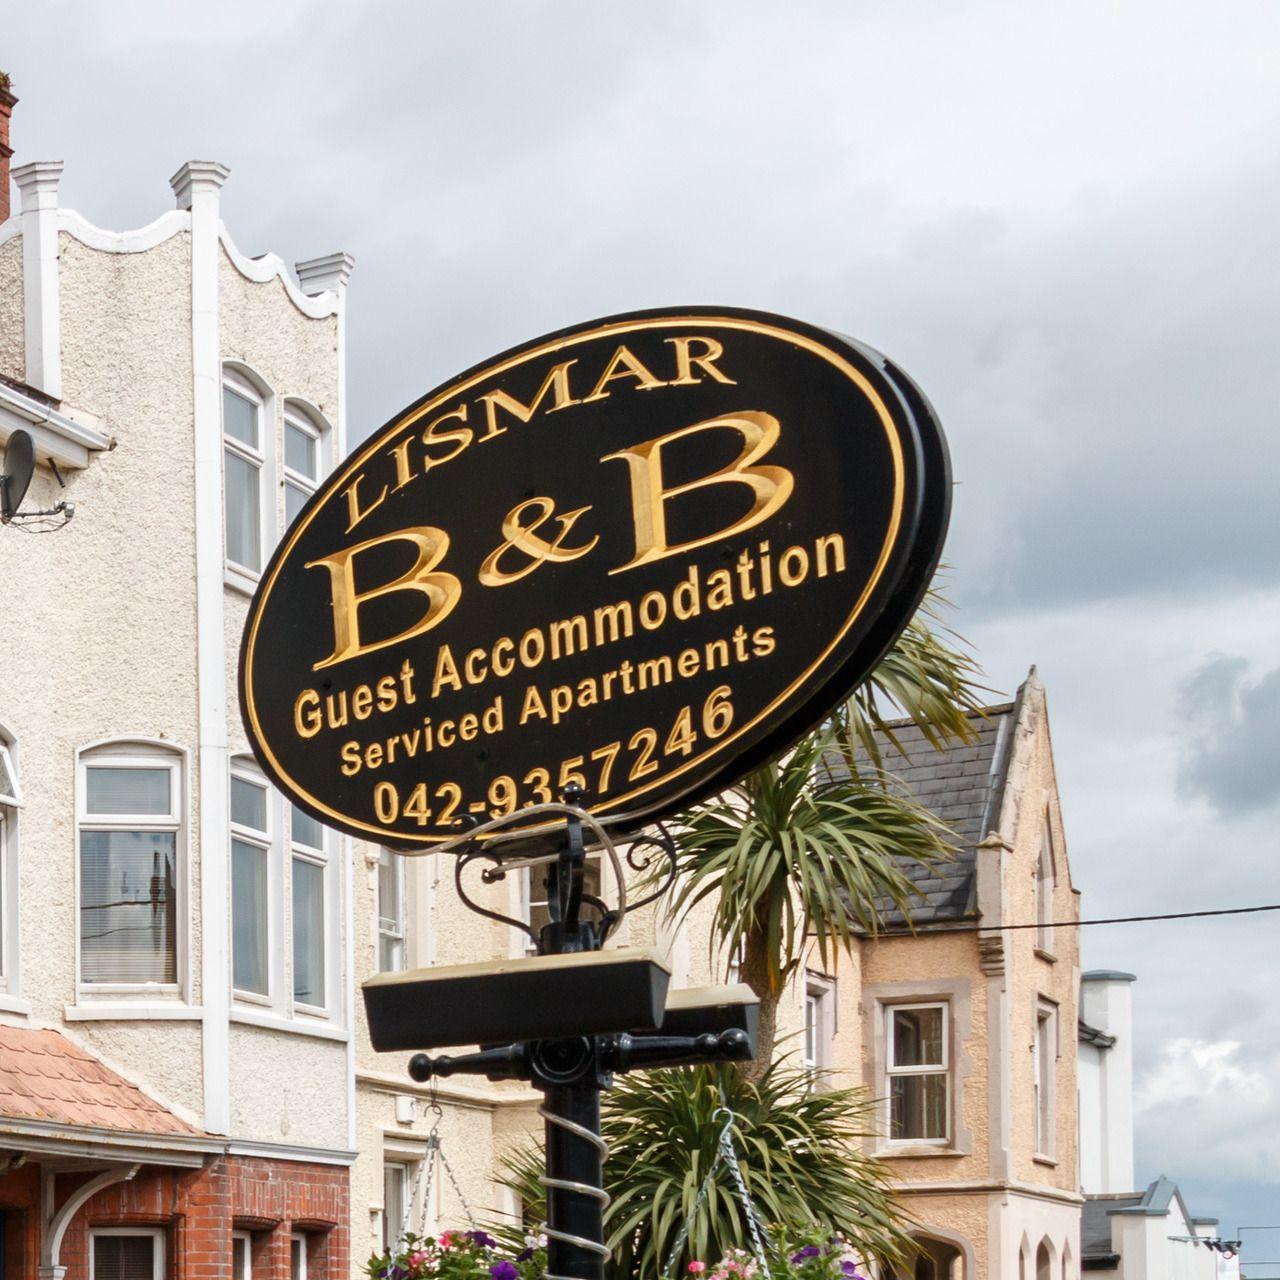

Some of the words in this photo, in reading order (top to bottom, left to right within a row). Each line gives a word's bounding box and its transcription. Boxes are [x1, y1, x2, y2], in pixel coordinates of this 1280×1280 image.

[340, 336, 738, 534] LISMAR
[293, 658, 416, 738] Guest
[431, 531, 847, 698] Accommodation
[340, 695, 504, 777] Serviced
[518, 624, 777, 725] Apartments
[373, 684, 736, 827] 042-9357246
